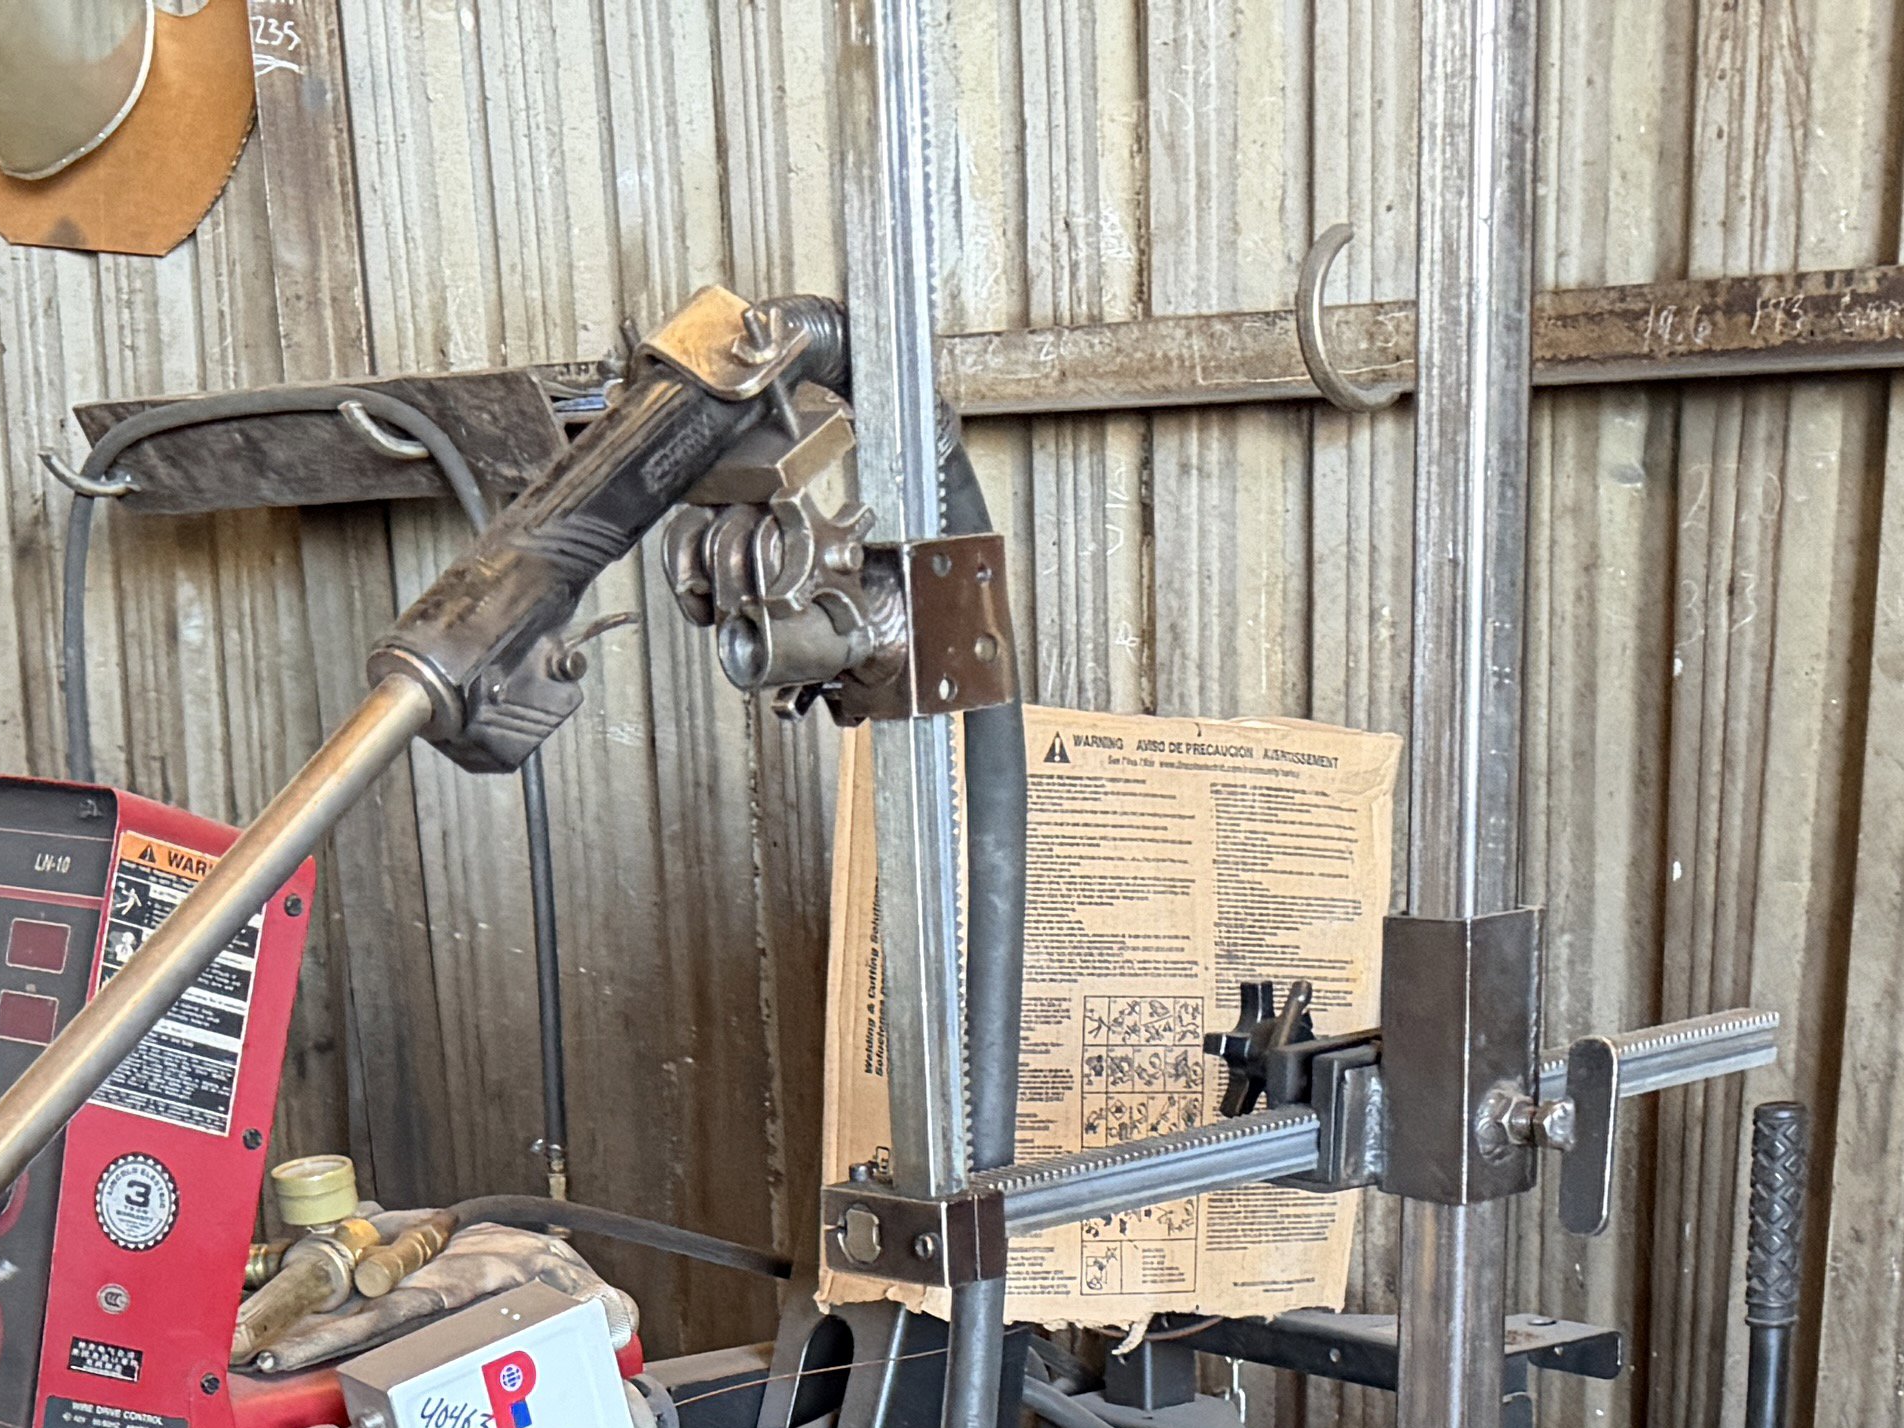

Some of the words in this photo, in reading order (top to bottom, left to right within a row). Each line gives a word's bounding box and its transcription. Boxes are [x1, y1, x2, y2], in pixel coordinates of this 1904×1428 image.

[1073, 734, 1124, 751] WARNING
[1136, 738, 1166, 753] AVISO
[1169, 741, 1184, 755] DE
[34, 852, 72, 874] LN-10
[167, 849, 216, 877] WAR
[867, 946, 880, 1000] Cutting
[864, 1018, 876, 1075] Welding
[124, 1179, 152, 1208] 3
